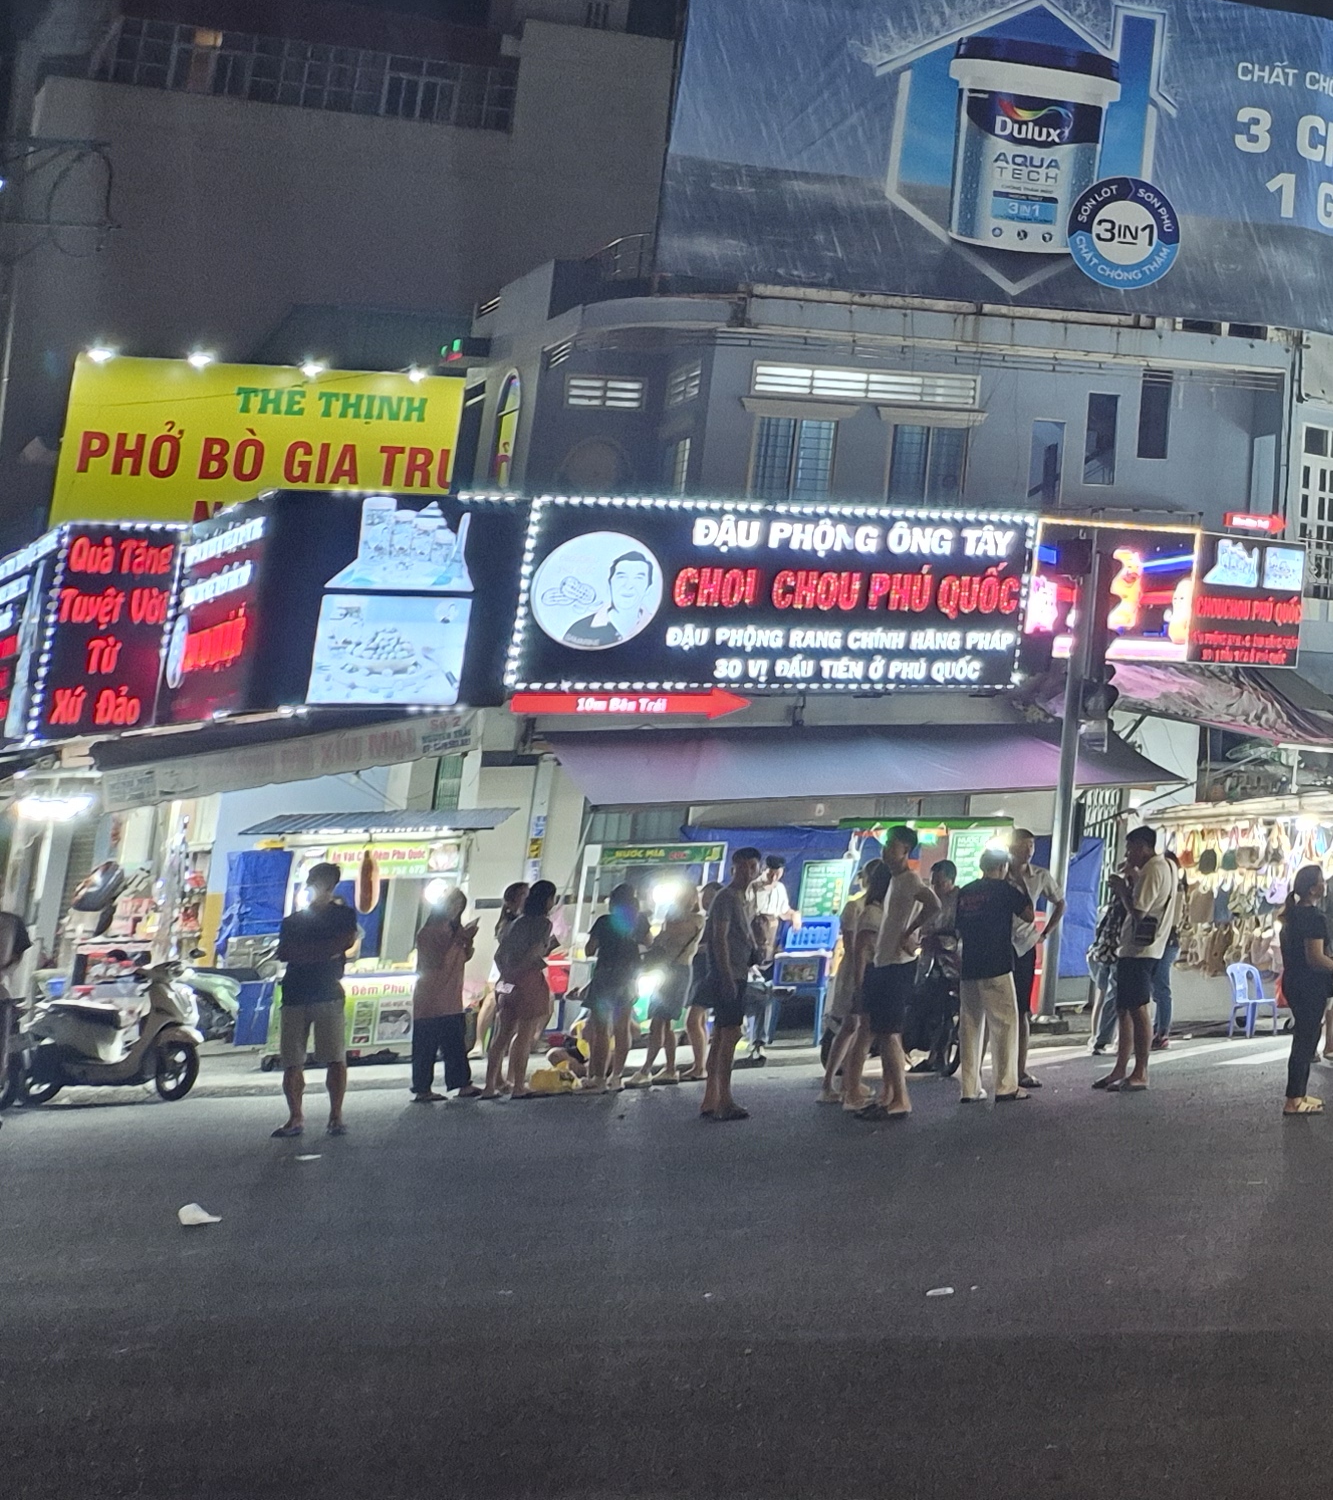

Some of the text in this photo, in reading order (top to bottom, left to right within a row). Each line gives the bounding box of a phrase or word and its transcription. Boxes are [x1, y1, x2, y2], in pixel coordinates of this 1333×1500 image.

[1237, 60, 1298, 87] CHẤT
[995, 114, 1061, 144] Dulux
[1234, 106, 1272, 154] 3
[993, 151, 1061, 171] AQUA
[996, 165, 1059, 184] TECH
[1078, 197, 1097, 223] SƠN
[1136, 188, 1161, 208] SƠN
[1265, 171, 1297, 219] 1
[318, 391, 429, 425] THỊNH
[76, 420, 184, 479] PHỞ
[198, 428, 265, 482] BÒ
[283, 441, 360, 487] GIA
[692, 514, 1016, 558] ĐẬU PHỘNG ÔNG TÂY
[69, 535, 116, 575] Quả
[771, 569, 862, 612] CHOU
[869, 563, 933, 612] PHÚ
[937, 561, 1021, 619] QUỐC
[666, 623, 711, 651] ĐẬU
[715, 624, 785, 652] PHỘNG
[788, 628, 843, 650] RANG
[846, 626, 906, 650] CHÍNH
[965, 628, 1016, 651] PHÁP
[86, 635, 122, 675] Từ
[713, 657, 743, 679] 30
[747, 658, 770, 683] VỊ
[887, 657, 927, 680] PHÚ
[930, 654, 983, 684] QUỐC
[49, 685, 141, 726] Xứ Đảo
